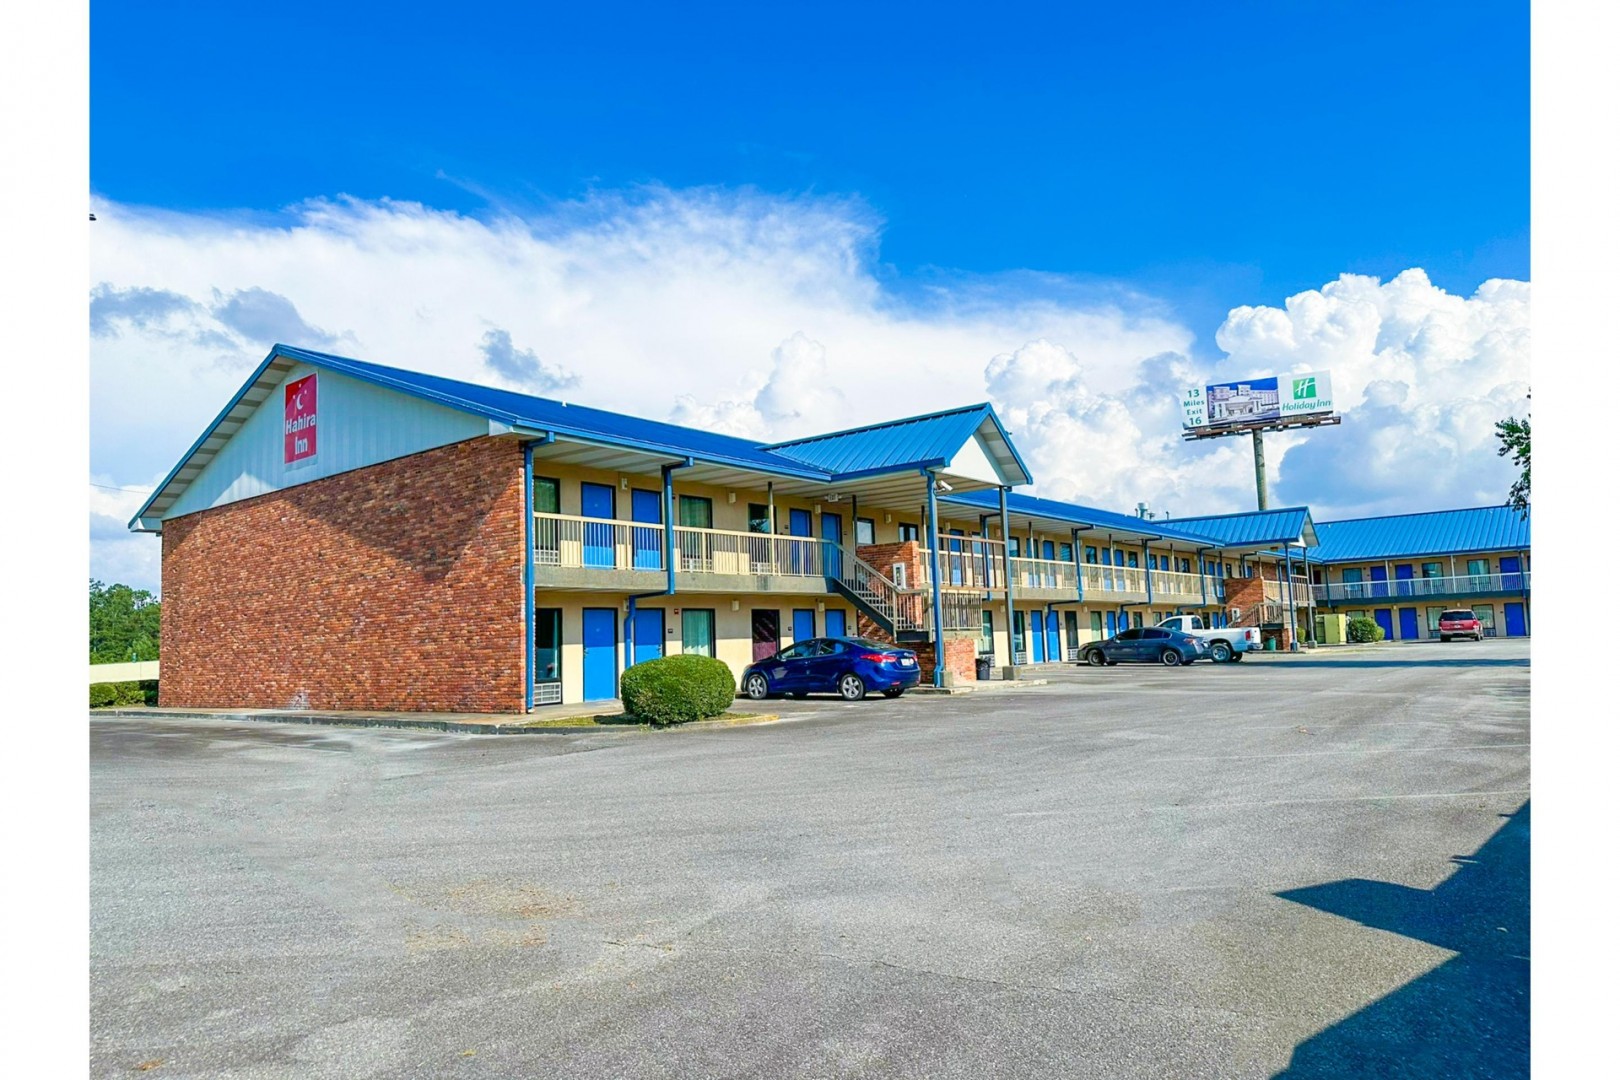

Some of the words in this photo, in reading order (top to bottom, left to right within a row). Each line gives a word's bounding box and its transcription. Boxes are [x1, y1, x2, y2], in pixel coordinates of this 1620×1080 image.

[1187, 389, 1200, 398] 13
[1183, 399, 1205, 407] Miles
[1282, 400, 1316, 412] Holiday
[1316, 399, 1331, 408] Inn
[1186, 408, 1203, 416] Exit
[285, 413, 316, 435] Hahira
[1189, 417, 1202, 426] 16
[294, 436, 308, 455] Inn
